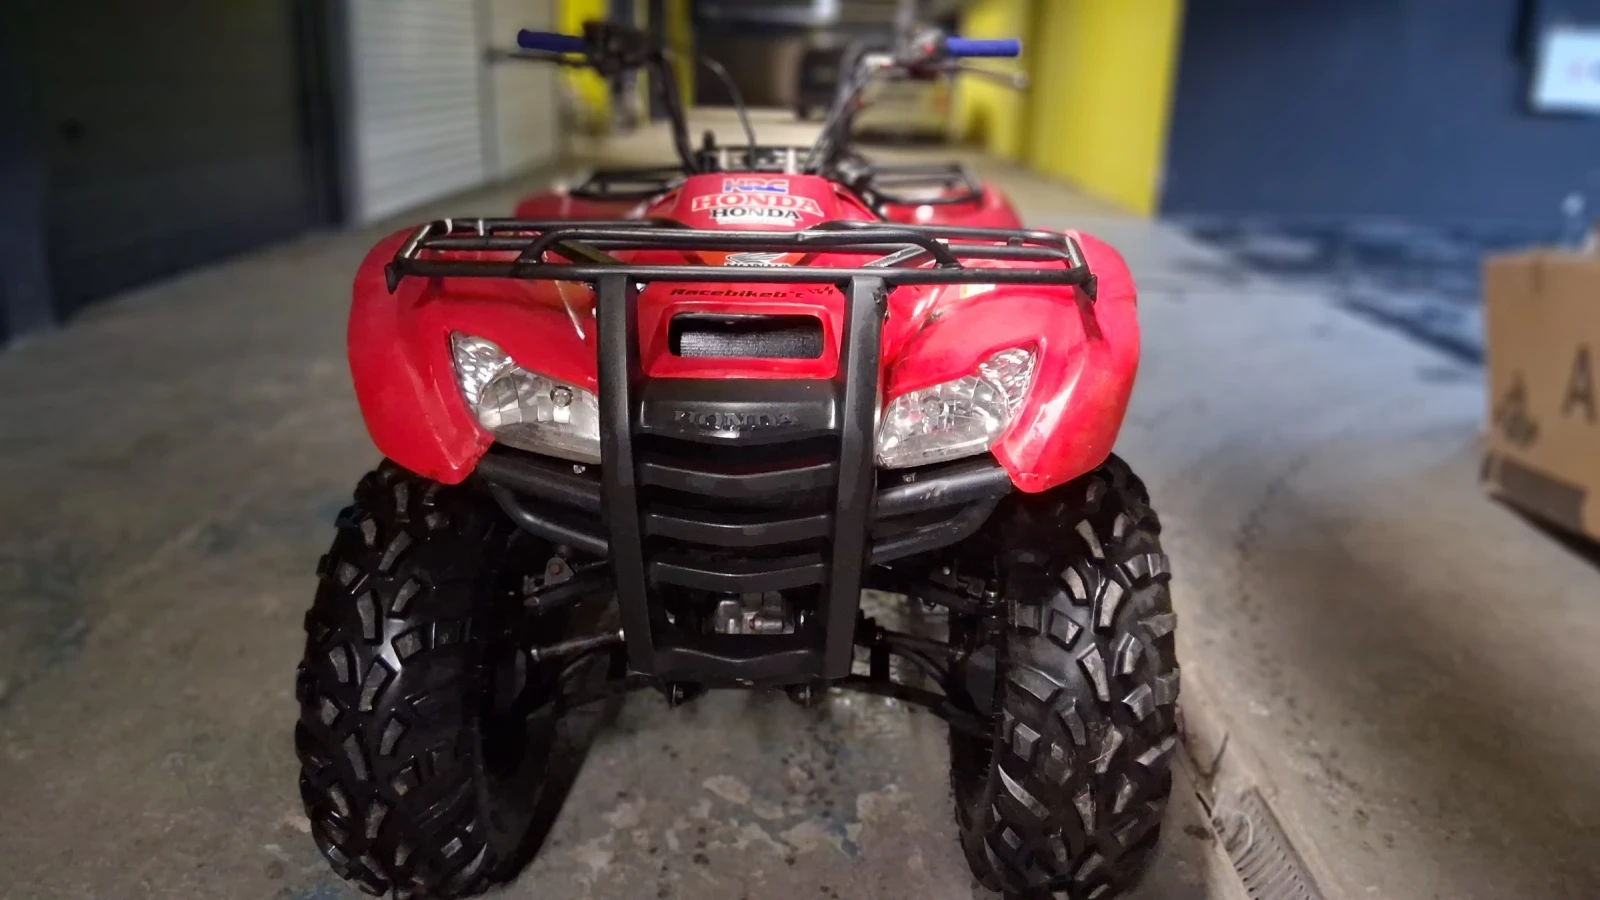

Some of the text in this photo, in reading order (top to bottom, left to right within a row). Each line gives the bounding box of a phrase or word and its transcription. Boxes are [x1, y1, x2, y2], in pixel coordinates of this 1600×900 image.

[723, 179, 788, 194] HRC
[693, 194, 823, 216] HONDA
[711, 208, 800, 219] HONDA
